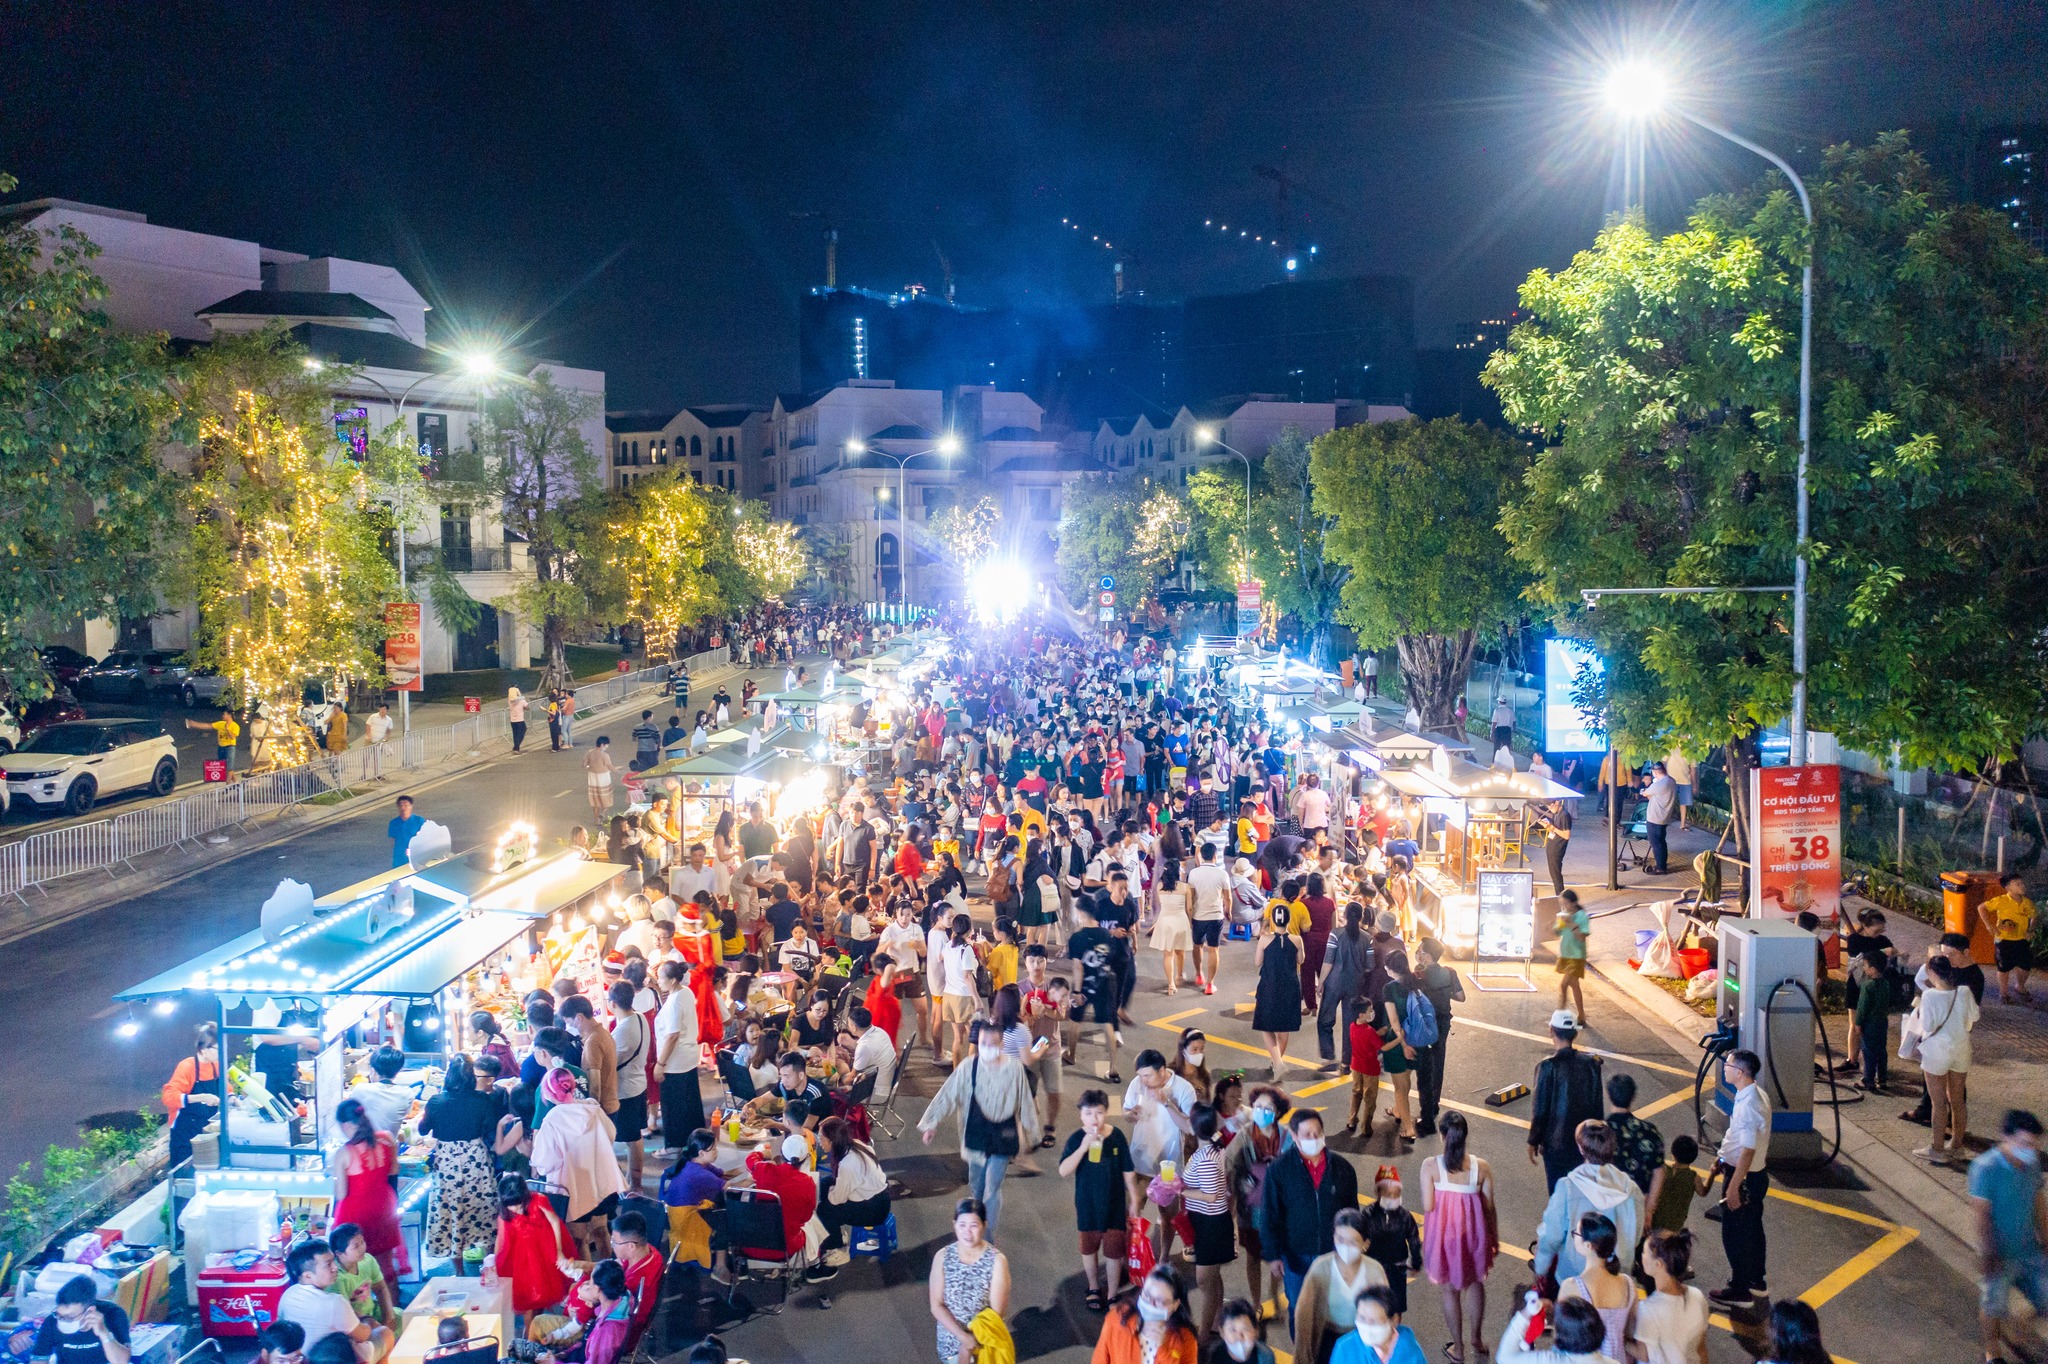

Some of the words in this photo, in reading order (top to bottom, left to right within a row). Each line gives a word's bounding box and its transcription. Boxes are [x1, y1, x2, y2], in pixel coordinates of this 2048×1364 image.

[398, 633, 416, 643] 38
[1763, 797, 1779, 806] CƠ
[1779, 796, 1797, 806] HỘI
[1800, 794, 1820, 805] ĐẦU
[1822, 794, 1836, 803] TƯ
[1790, 835, 1830, 861] 38
[1769, 862, 1798, 873] TRIỆU
[1800, 861, 1830, 872] ĐỒNG
